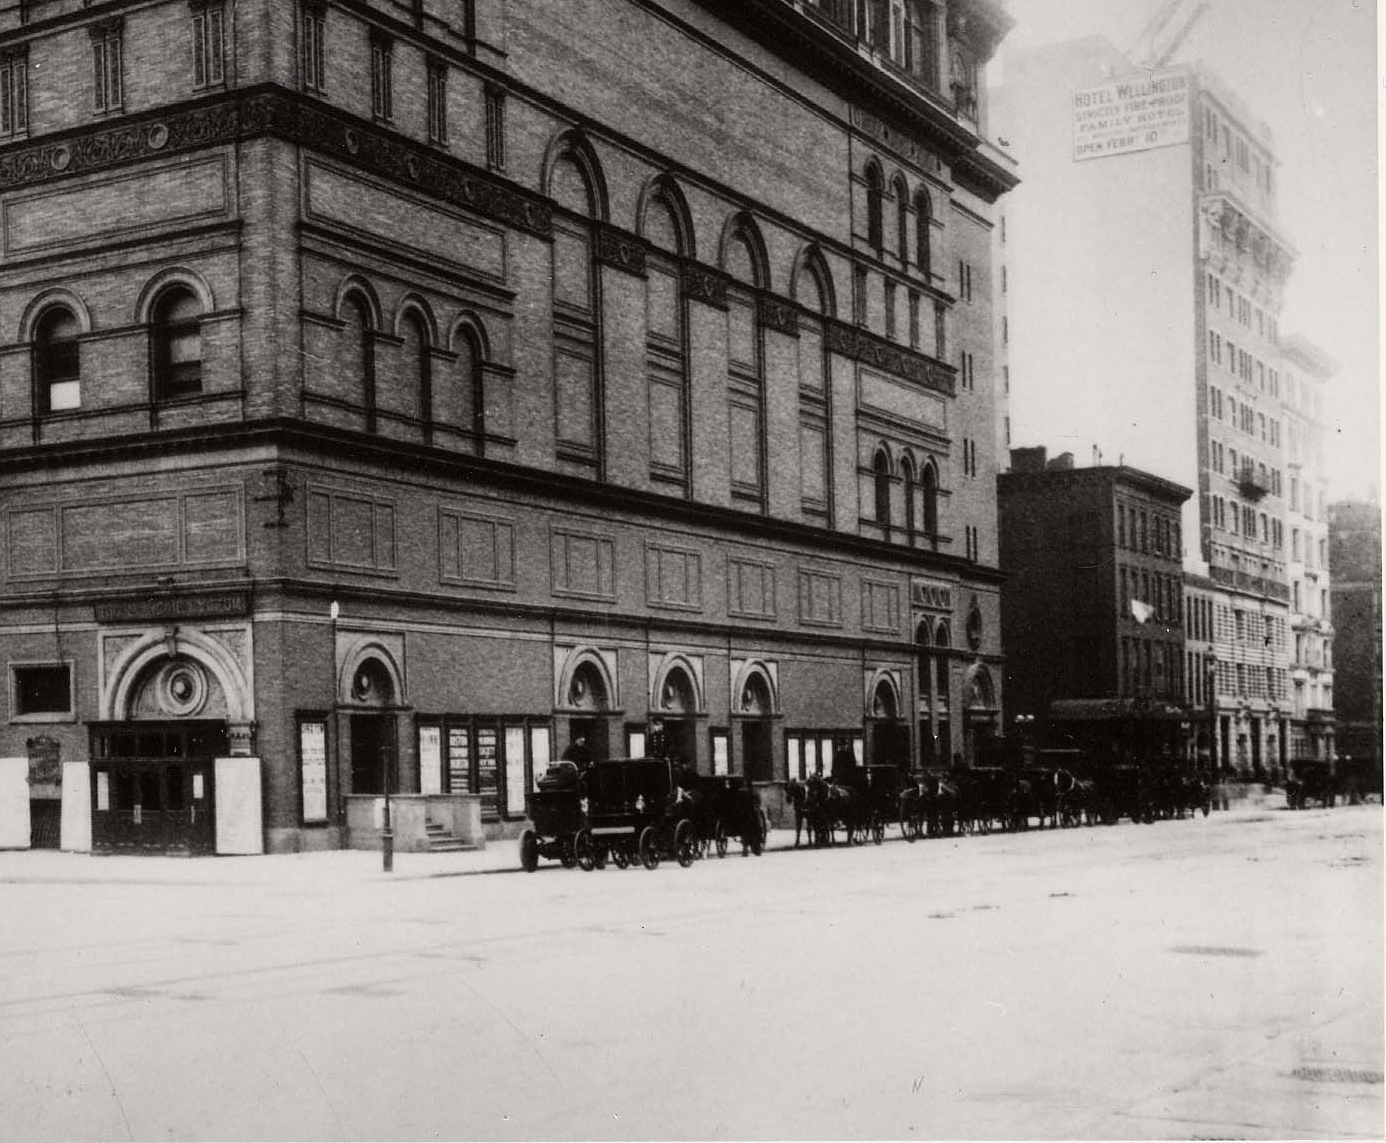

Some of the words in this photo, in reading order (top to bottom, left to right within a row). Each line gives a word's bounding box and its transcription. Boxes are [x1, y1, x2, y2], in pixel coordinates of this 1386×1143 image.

[1074, 90, 1113, 108] HOTEL
[1116, 77, 1186, 99] WELLINGTON
[1079, 116, 1132, 132] FAMILY
[1136, 108, 1185, 122] HOTEL
[1076, 142, 1103, 155] OPEN
